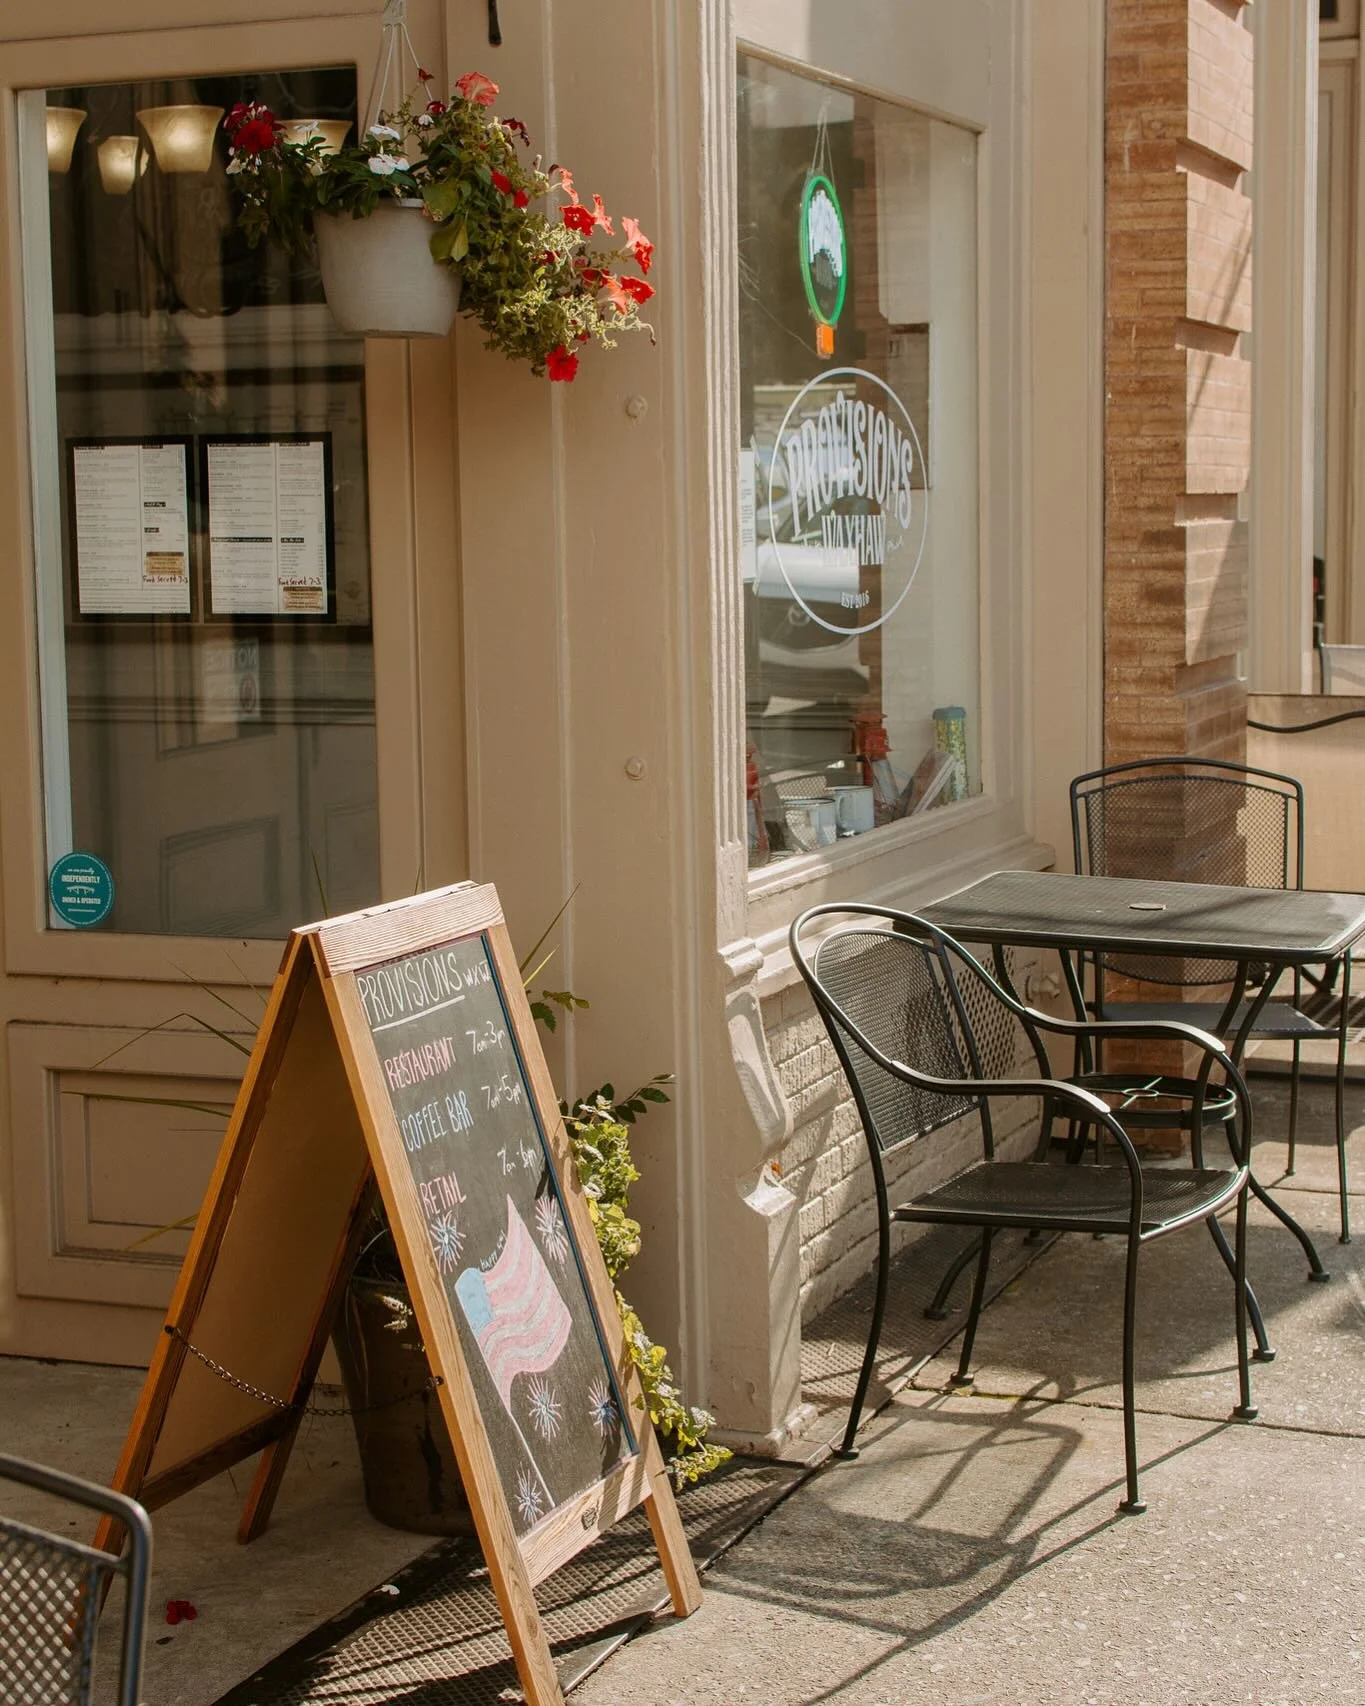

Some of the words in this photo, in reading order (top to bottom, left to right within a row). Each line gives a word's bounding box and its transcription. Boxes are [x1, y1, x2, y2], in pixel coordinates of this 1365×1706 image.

[785, 390, 913, 536] PROVISIONS
[357, 952, 463, 1025] PROVISIONS
[384, 1037, 457, 1092] RESTAURANT
[402, 1101, 447, 1152] COFFEE
[448, 1090, 474, 1135] BAR
[420, 1172, 467, 1219] RETAIL
